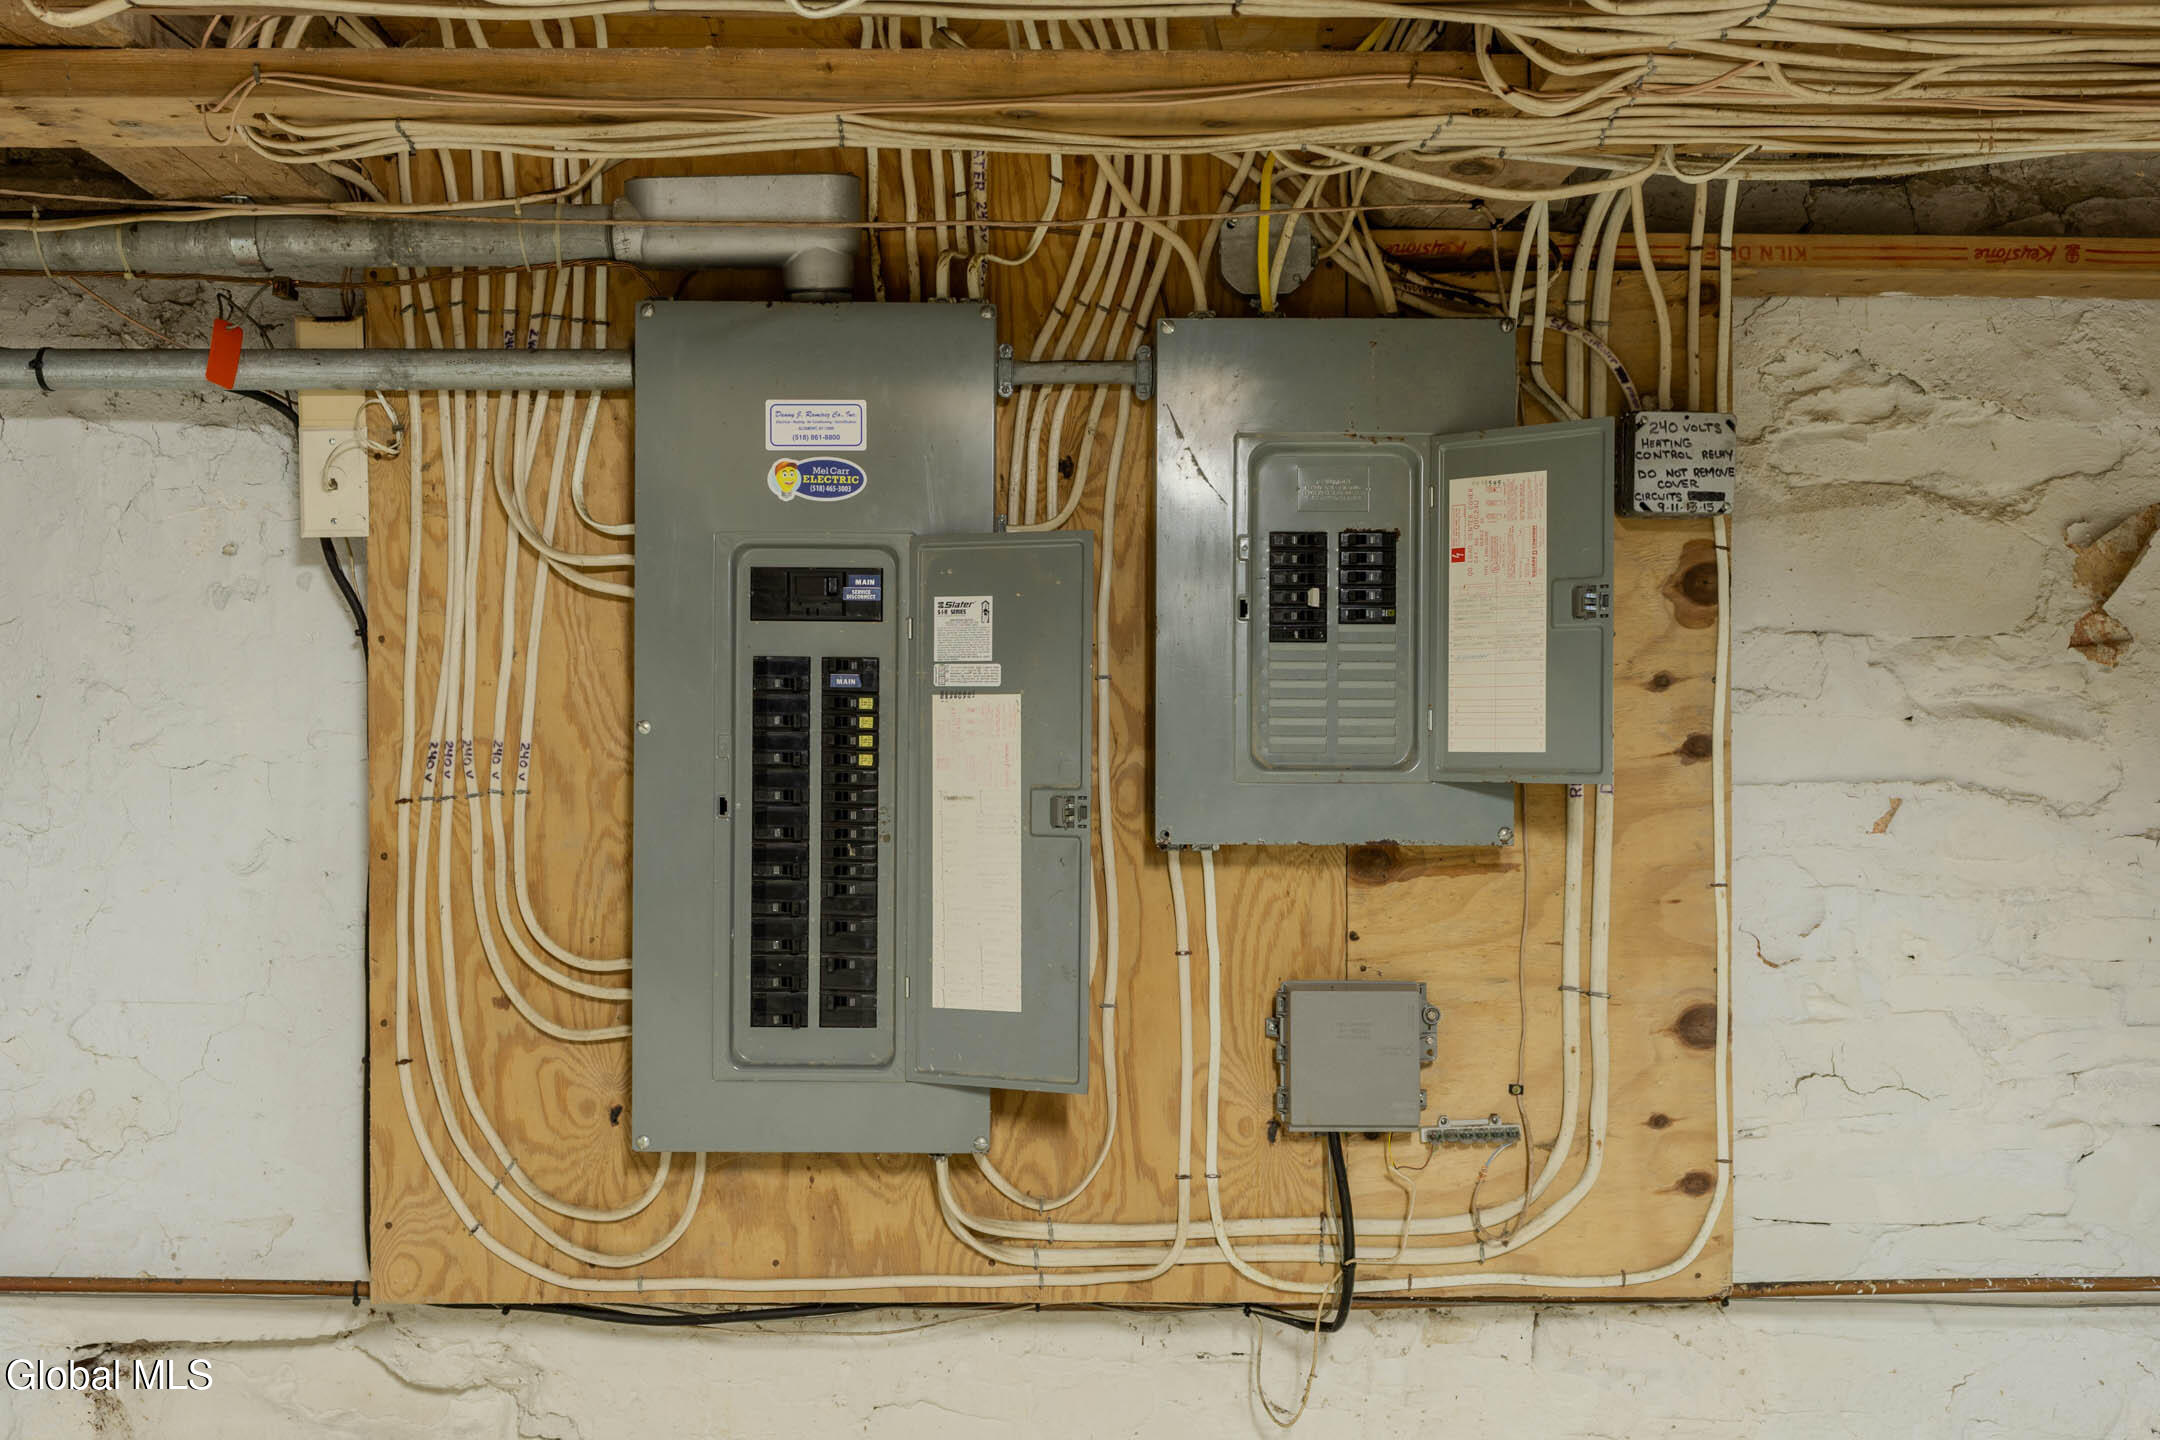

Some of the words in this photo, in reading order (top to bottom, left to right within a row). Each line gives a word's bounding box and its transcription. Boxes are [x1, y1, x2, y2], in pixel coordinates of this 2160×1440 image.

[1760, 246, 1808, 262] KILN
[1974, 245, 2056, 264] Keystone
[1649, 420, 1678, 434] 240
[1683, 422, 1722, 434] VOLTS
[1641, 438, 1692, 449] HEATING
[1635, 450, 1693, 460] CONTROL
[1702, 450, 1734, 460] RELAY
[812, 467, 828, 475] Mel
[830, 467, 850, 475] Carr
[1638, 469, 1657, 479] DO
[1666, 468, 1687, 478] NOT
[1694, 467, 1735, 478] REMOVE
[803, 475, 859, 484] ELECTRIC
[1658, 480, 1699, 489] COVER
[810, 485, 825, 493] (518)
[1634, 492, 1682, 502] CIRCUITS
[426, 742, 438, 769] 240
[444, 741, 454, 768] 240
[462, 739, 473, 766] 240
[492, 740, 503, 764] 240
[519, 742, 530, 768] 240
[424, 773, 432, 782] V
[444, 770, 451, 779] V
[465, 770, 474, 779] V
[492, 771, 500, 779] V
